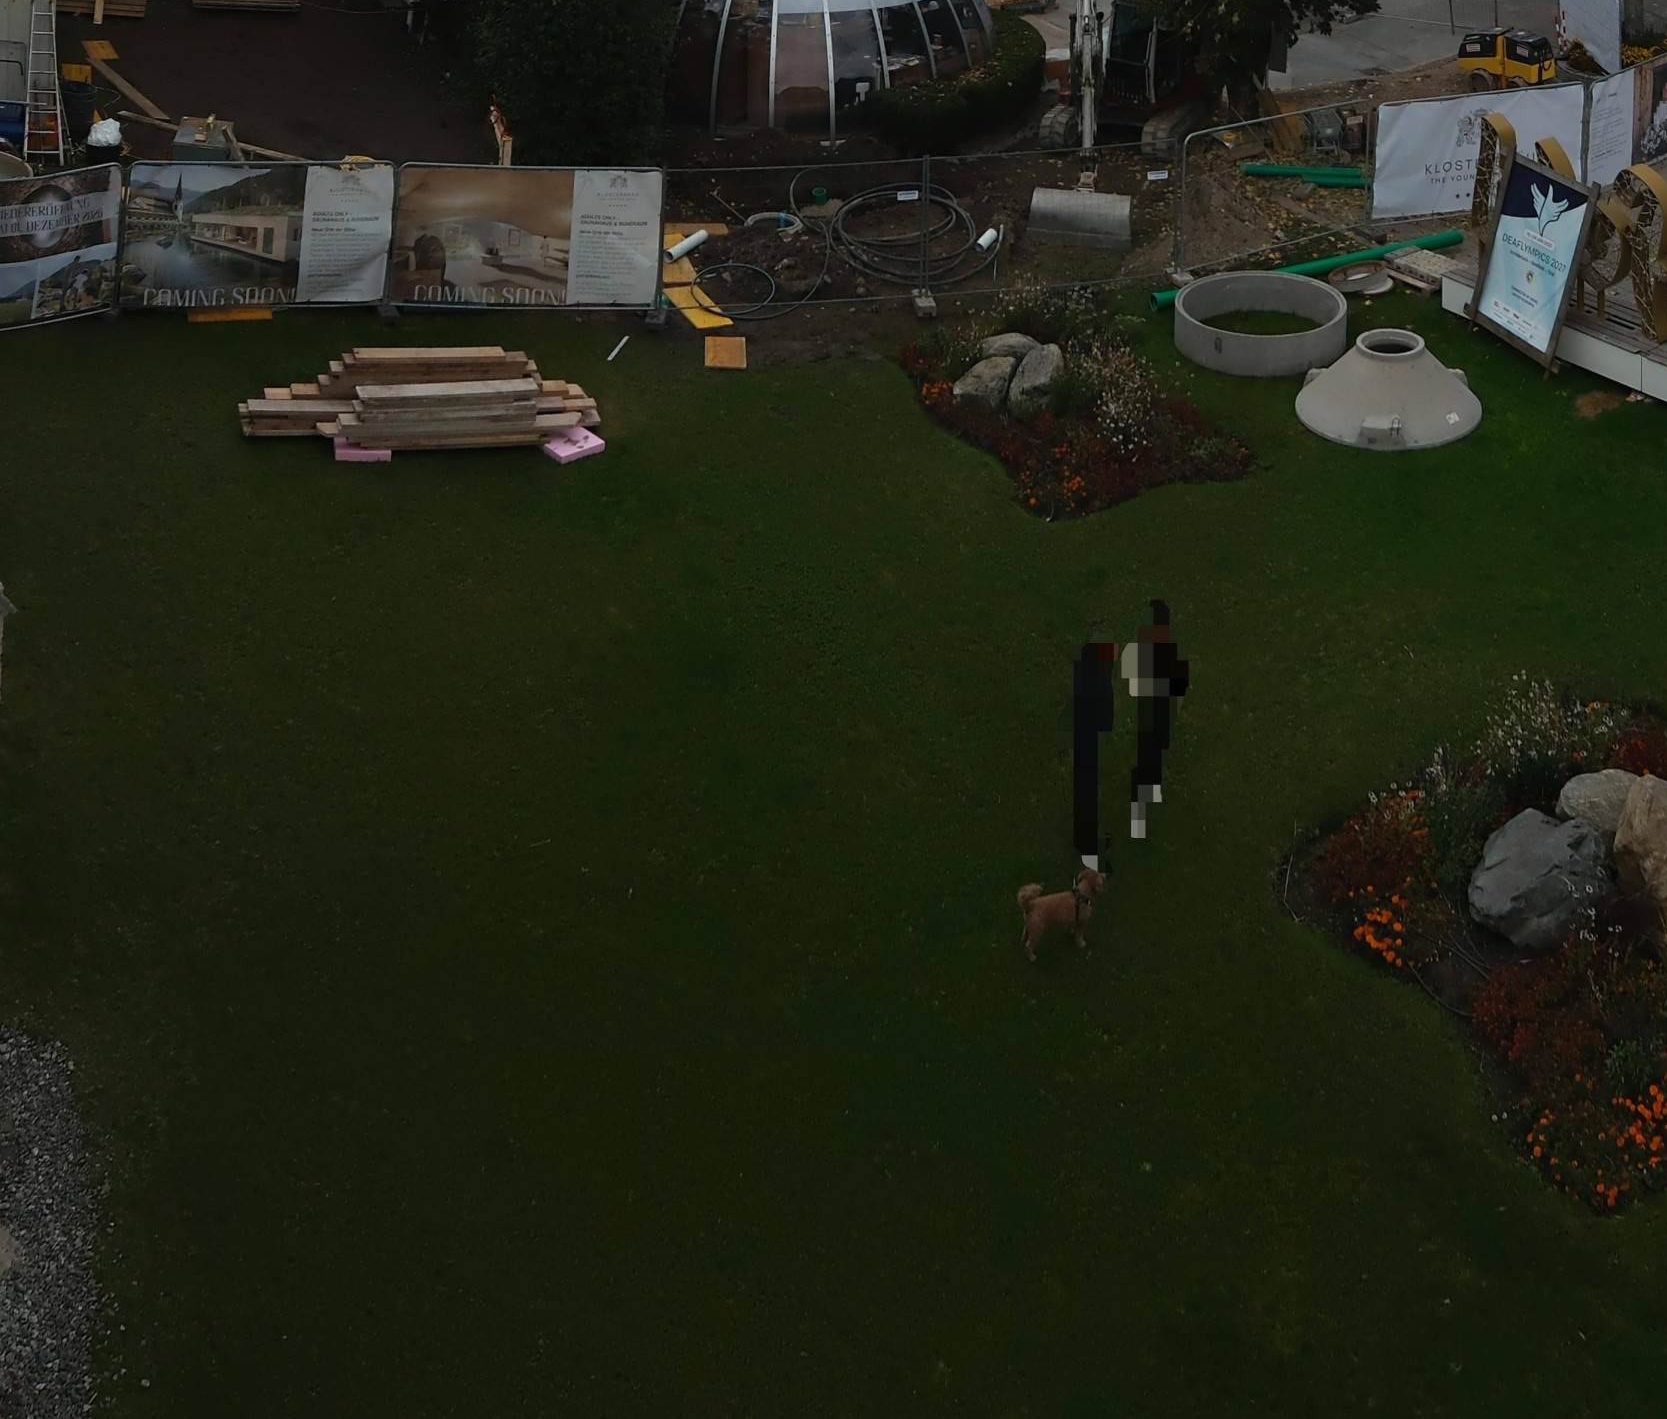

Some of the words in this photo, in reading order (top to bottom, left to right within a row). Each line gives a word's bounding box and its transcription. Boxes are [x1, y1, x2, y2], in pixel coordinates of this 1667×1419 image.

[1430, 177, 1447, 185] THE
[1450, 174, 1475, 182] YOUN
[1502, 233, 1550, 264] DEAFLYMPICS
[1550, 258, 1566, 273] 2027
